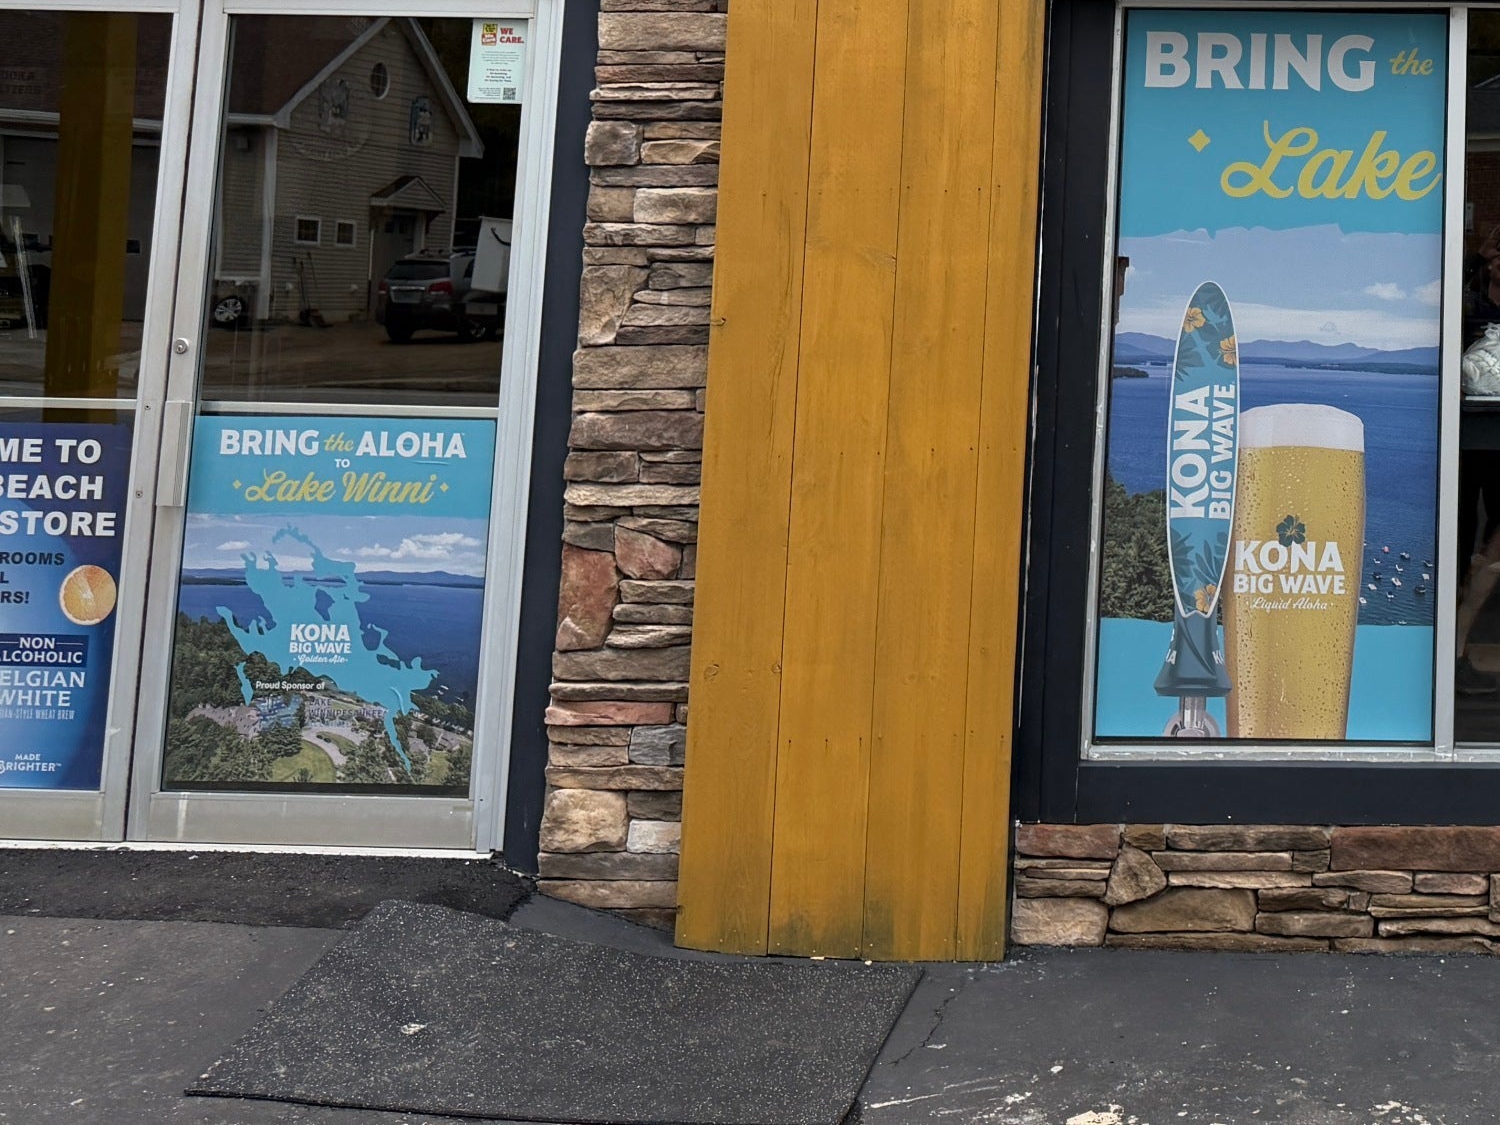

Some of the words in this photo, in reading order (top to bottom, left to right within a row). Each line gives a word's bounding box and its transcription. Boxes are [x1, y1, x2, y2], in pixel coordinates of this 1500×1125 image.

[500, 27, 513, 35] WE
[1143, 31, 1377, 92] BRING
[1389, 49, 1433, 76] the
[1220, 120, 1443, 202] Lake
[1211, 384, 1235, 464] WAVE
[55, 439, 102, 464] TO
[219, 429, 320, 456] BRING
[323, 432, 353, 452] the
[355, 431, 467, 458] ALOHA
[1170, 385, 1211, 519] KONA
[334, 458, 351, 468] TO
[0, 475, 104, 500] EACH
[244, 468, 337, 502] Lake
[341, 471, 438, 504] Winni
[1209, 470, 1232, 520] BIG
[0, 510, 117, 536] STORE
[1234, 540, 1345, 574] KONA
[1233, 573, 1274, 594] BIG
[1278, 574, 1346, 595] WAVE
[1252, 596, 1292, 613] Liquid
[1292, 597, 1328, 610] Aloha
[19, 637, 55, 649] NON
[290, 624, 351, 643] KONA
[0, 650, 83, 664] LCOHOLIC
[289, 642, 312, 654] BIG
[314, 642, 352, 654] WAVE
[255, 681, 280, 690] Proud
[281, 681, 315, 691] Sponsor
[316, 681, 326, 690] of
[309, 698, 331, 706] LAKE
